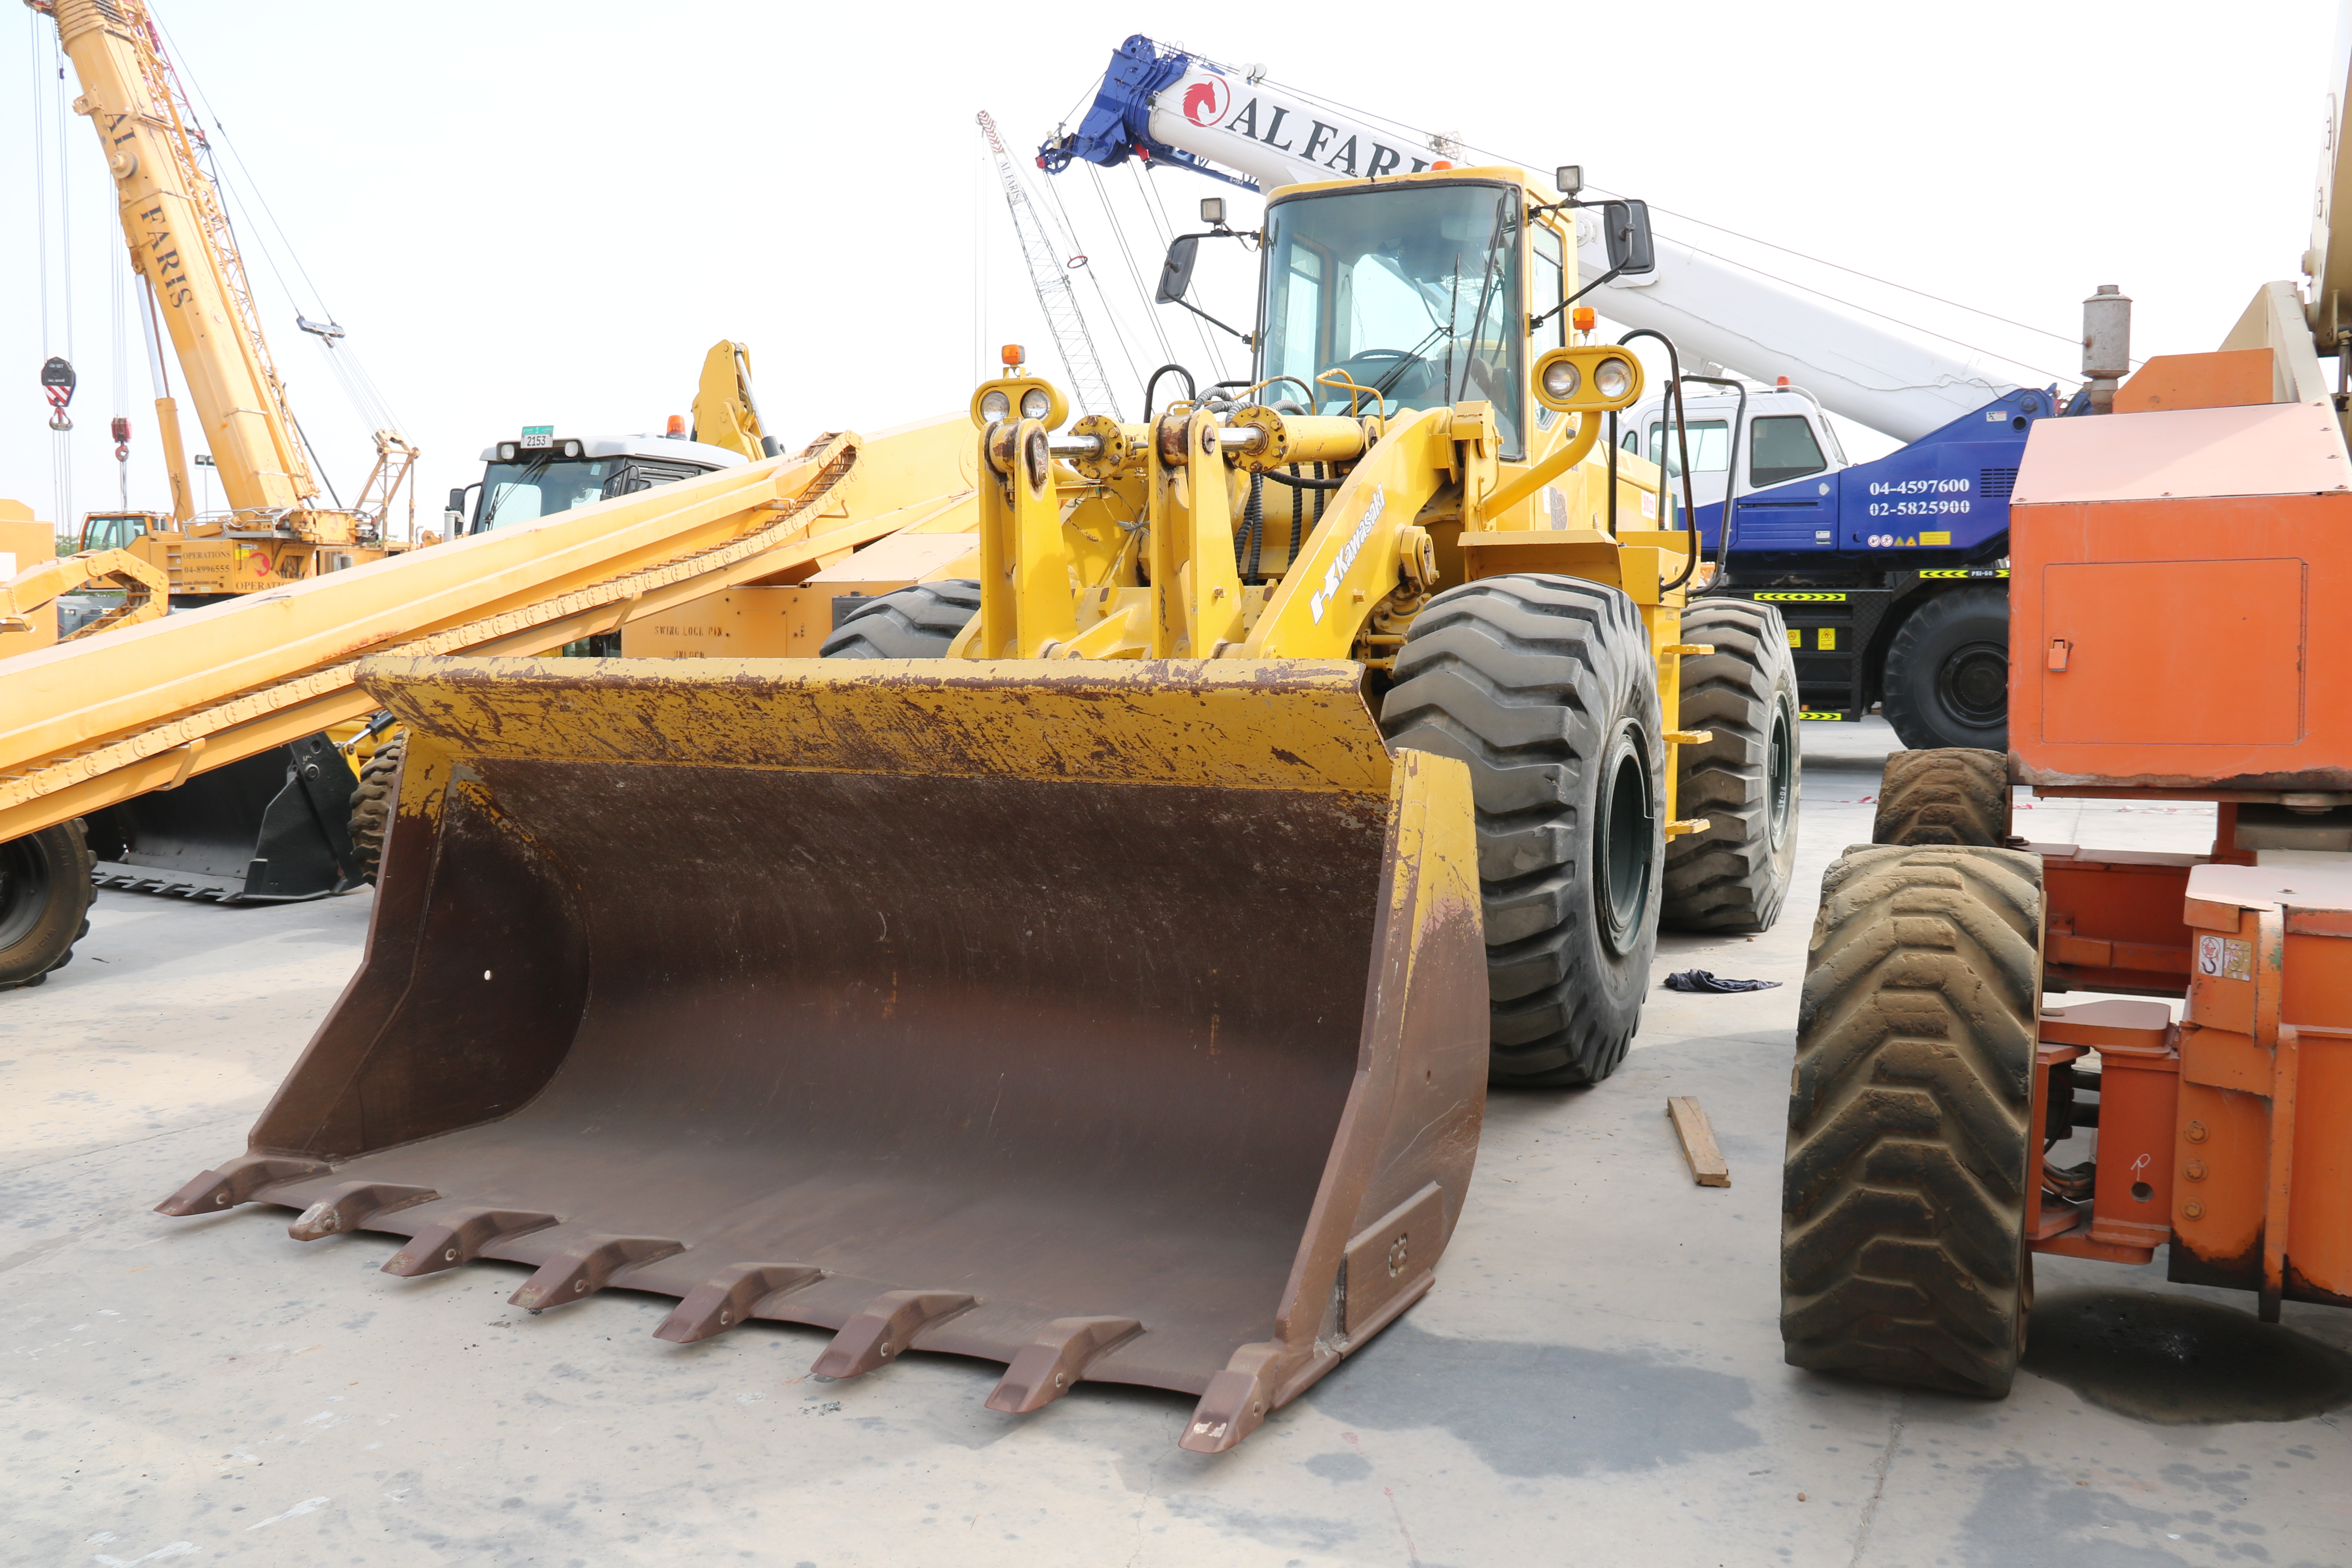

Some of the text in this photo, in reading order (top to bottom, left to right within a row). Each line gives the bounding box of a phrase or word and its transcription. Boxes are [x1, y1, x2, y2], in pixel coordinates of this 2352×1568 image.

[1225, 97, 1292, 151] AL
[140, 204, 194, 309] FARIS
[527, 436, 546, 446] 2153
[1869, 479, 1970, 495] 04-4597600
[1869, 500, 1970, 516] 02-5825900
[1334, 482, 1386, 582] Kawasaki
[183, 551, 230, 559] OPERATIONS
[184, 565, 230, 573] 04-8996555
[236, 581, 292, 590] OPERATI
[655, 626, 722, 636] SWING LOCK PIN
